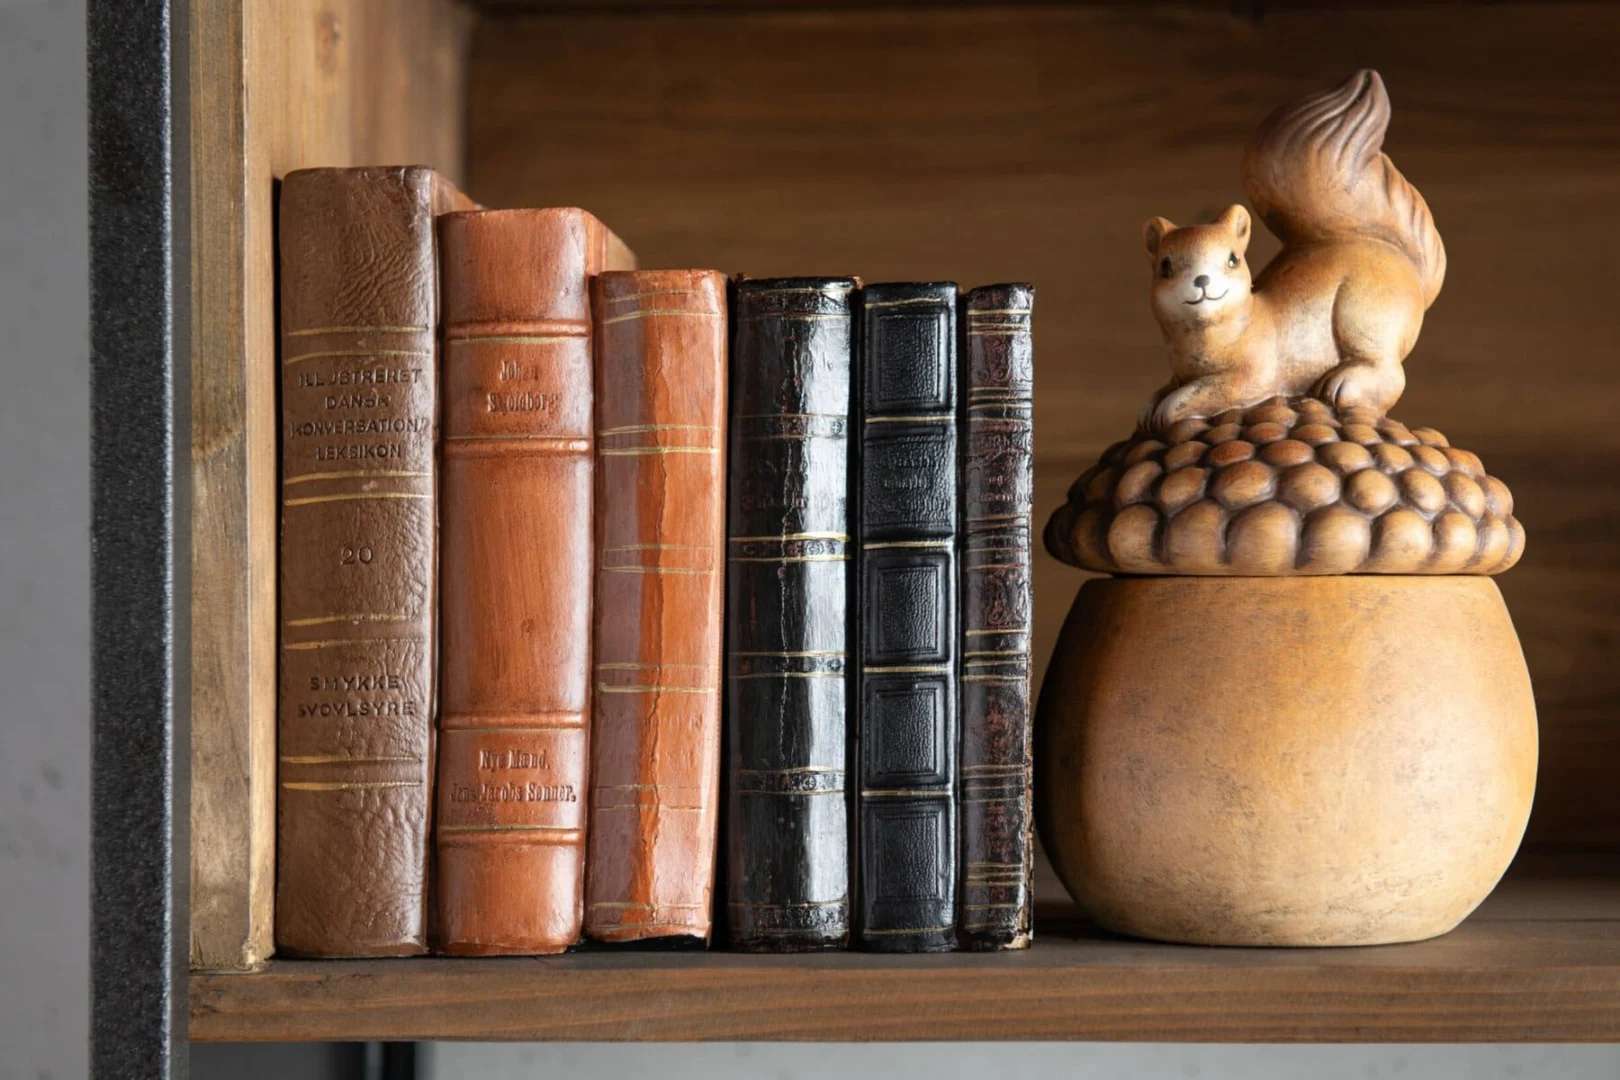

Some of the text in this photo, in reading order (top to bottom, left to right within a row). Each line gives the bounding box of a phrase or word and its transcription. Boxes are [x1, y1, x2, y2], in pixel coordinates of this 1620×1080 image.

[316, 443, 401, 461] LEKSIKON
[340, 545, 374, 566] 20
[298, 700, 417, 718] SVOVLSYRE
